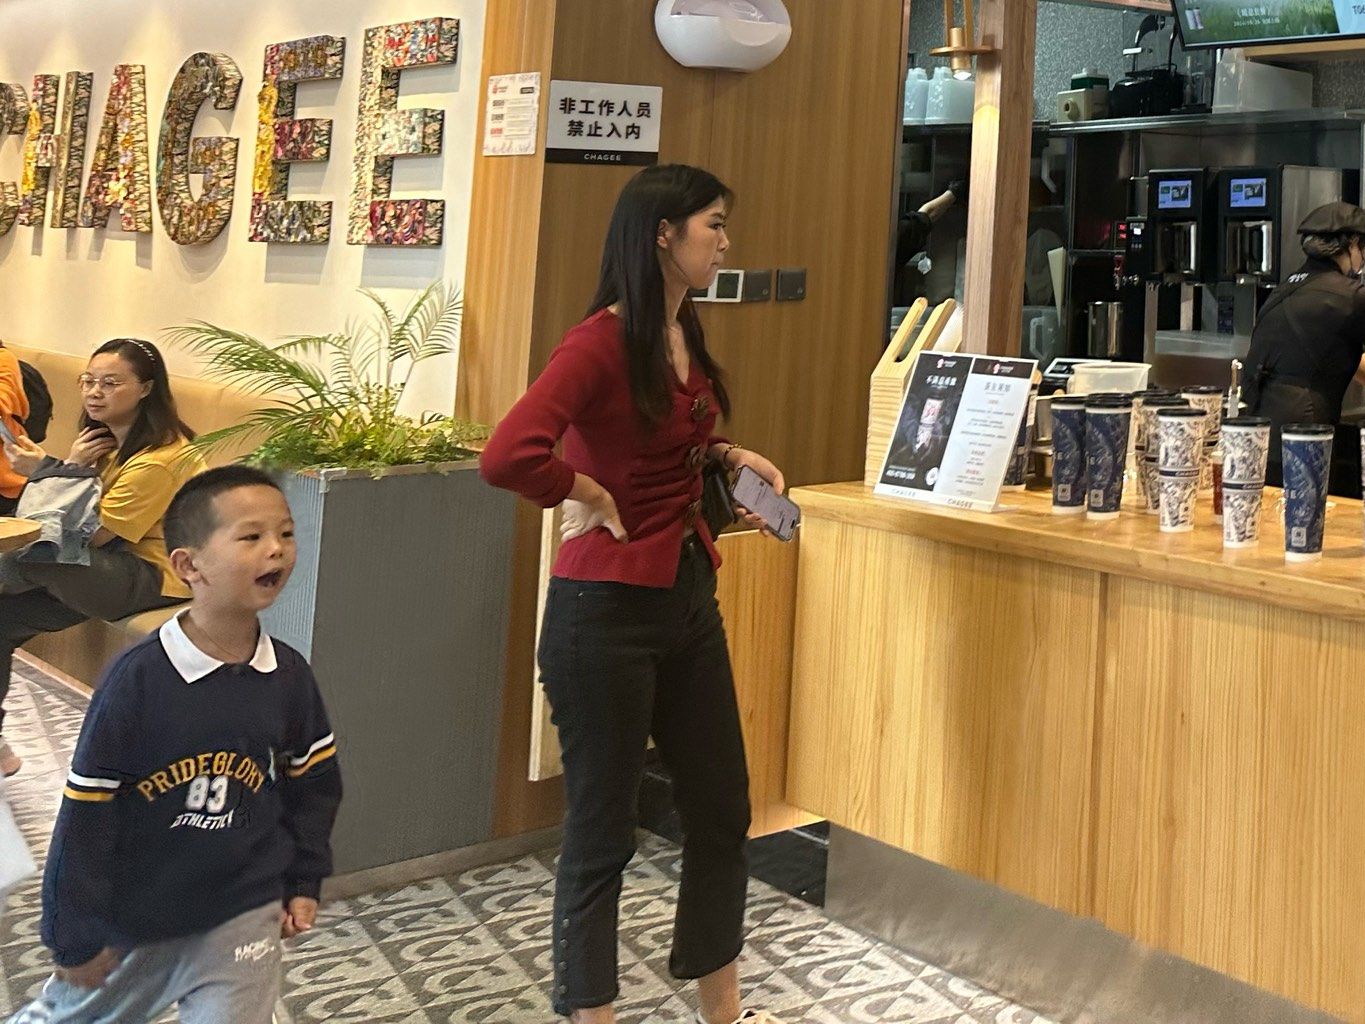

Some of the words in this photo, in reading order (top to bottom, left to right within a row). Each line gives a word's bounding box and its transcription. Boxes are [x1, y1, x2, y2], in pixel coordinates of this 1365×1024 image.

[559, 97, 651, 118] 非工作人员
[567, 120, 641, 140] 禁止入内
[583, 153, 622, 162] CHAGEE
[185, 775, 228, 813] 83
